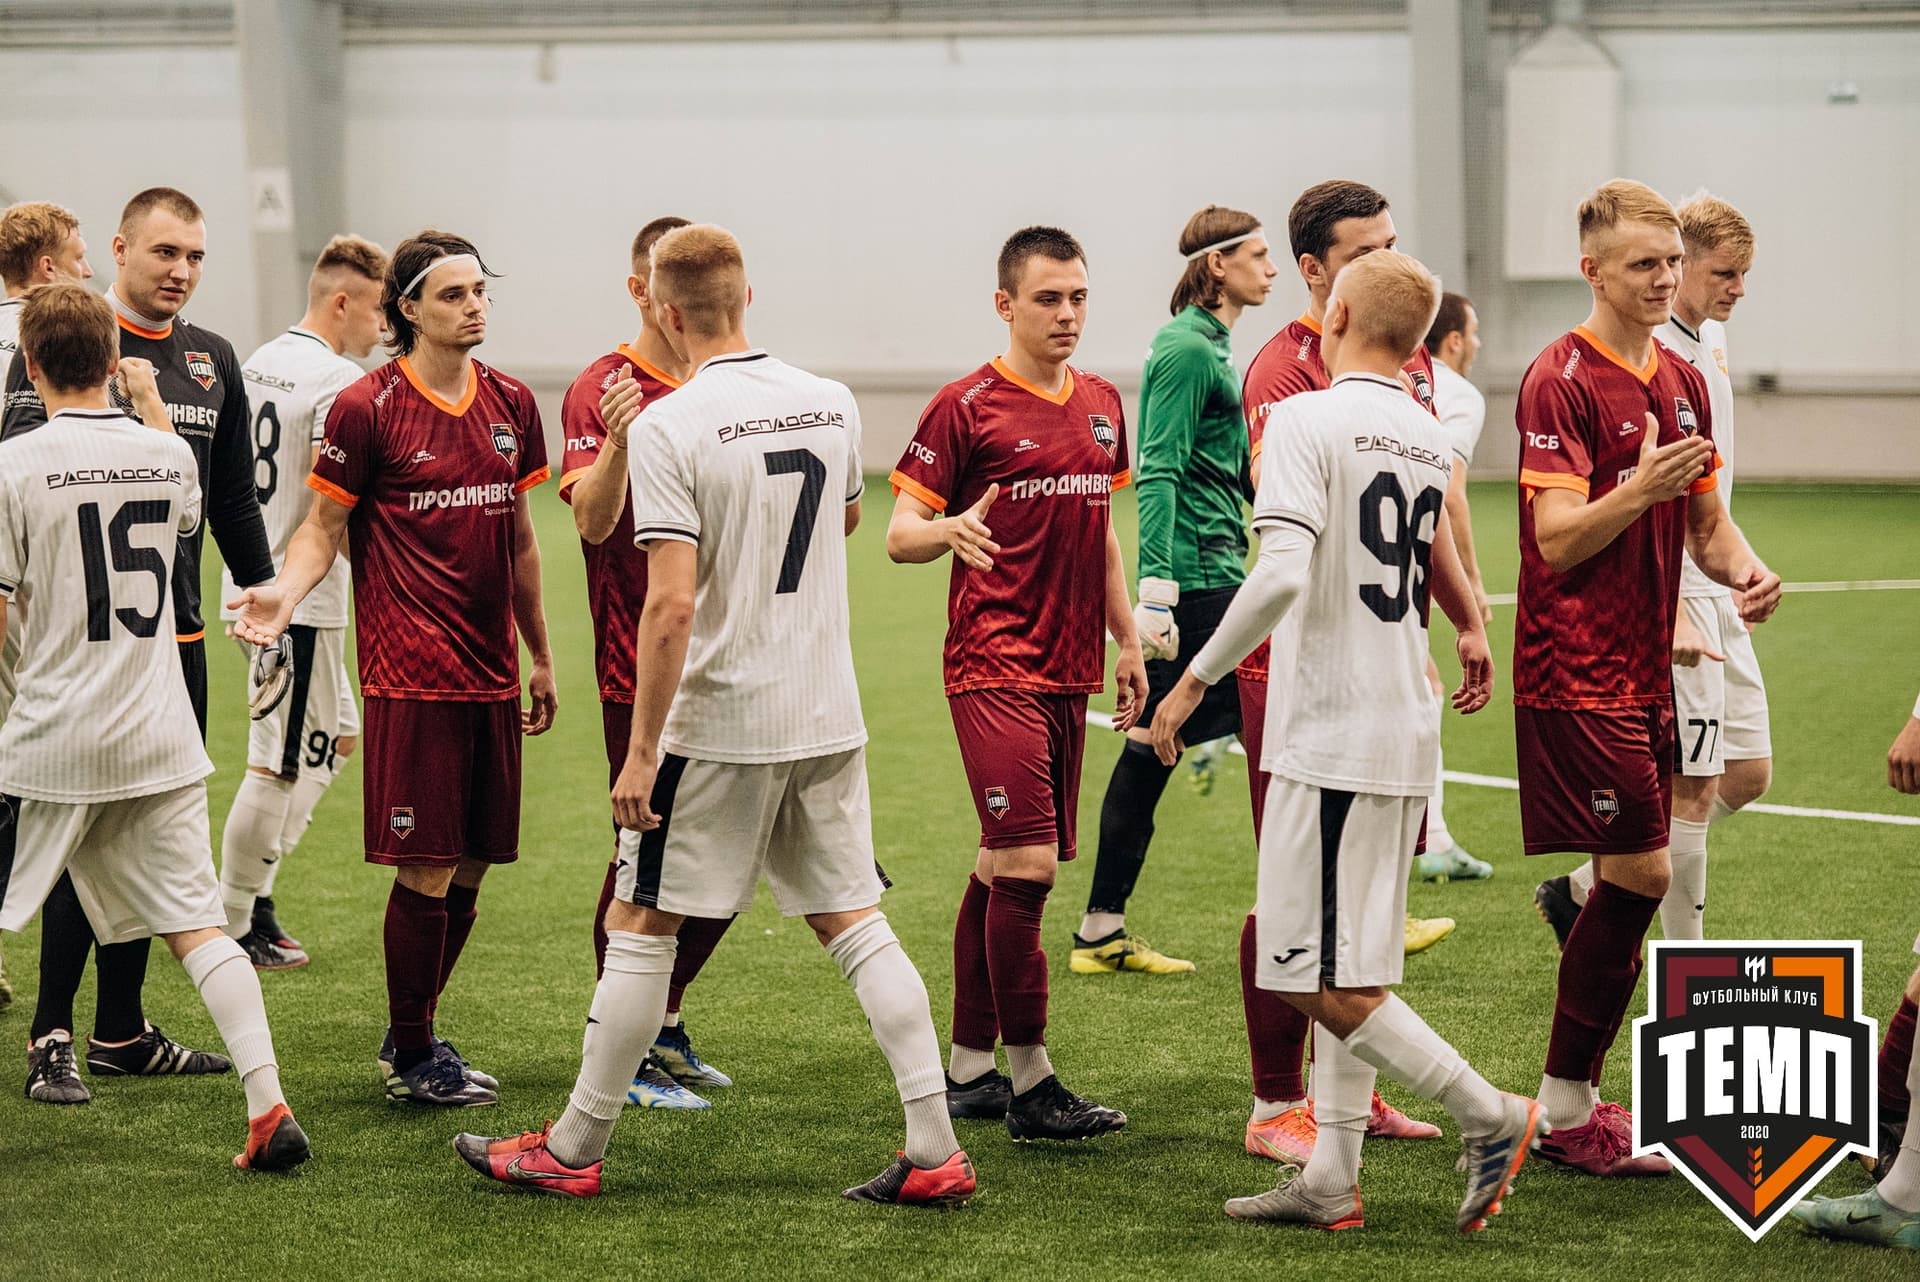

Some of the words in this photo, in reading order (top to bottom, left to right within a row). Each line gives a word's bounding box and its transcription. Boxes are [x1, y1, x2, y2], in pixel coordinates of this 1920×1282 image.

[248, 401, 281, 505] 8
[567, 435, 597, 451] ПСБ
[909, 440, 937, 465] ПСБ
[409, 482, 516, 512] ПРОДИНВЕС
[1012, 474, 1113, 501] ПРОДИНВЕС
[763, 448, 827, 595] 7
[77, 500, 171, 642] 15
[1688, 719, 1718, 762] 77
